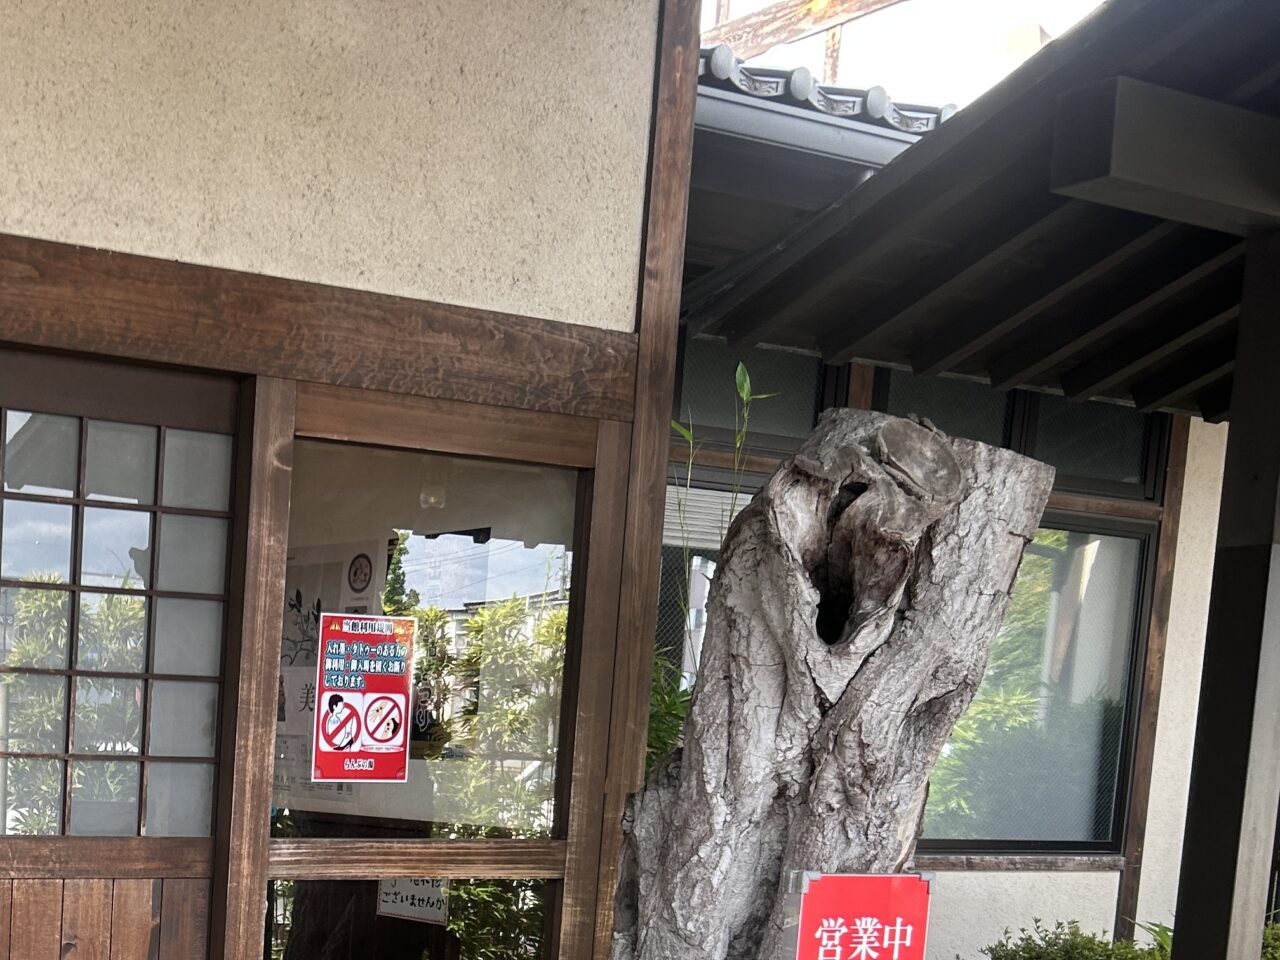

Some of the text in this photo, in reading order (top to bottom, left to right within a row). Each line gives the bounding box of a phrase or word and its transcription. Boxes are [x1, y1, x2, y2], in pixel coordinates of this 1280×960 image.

[324, 674, 366, 688] しております。
